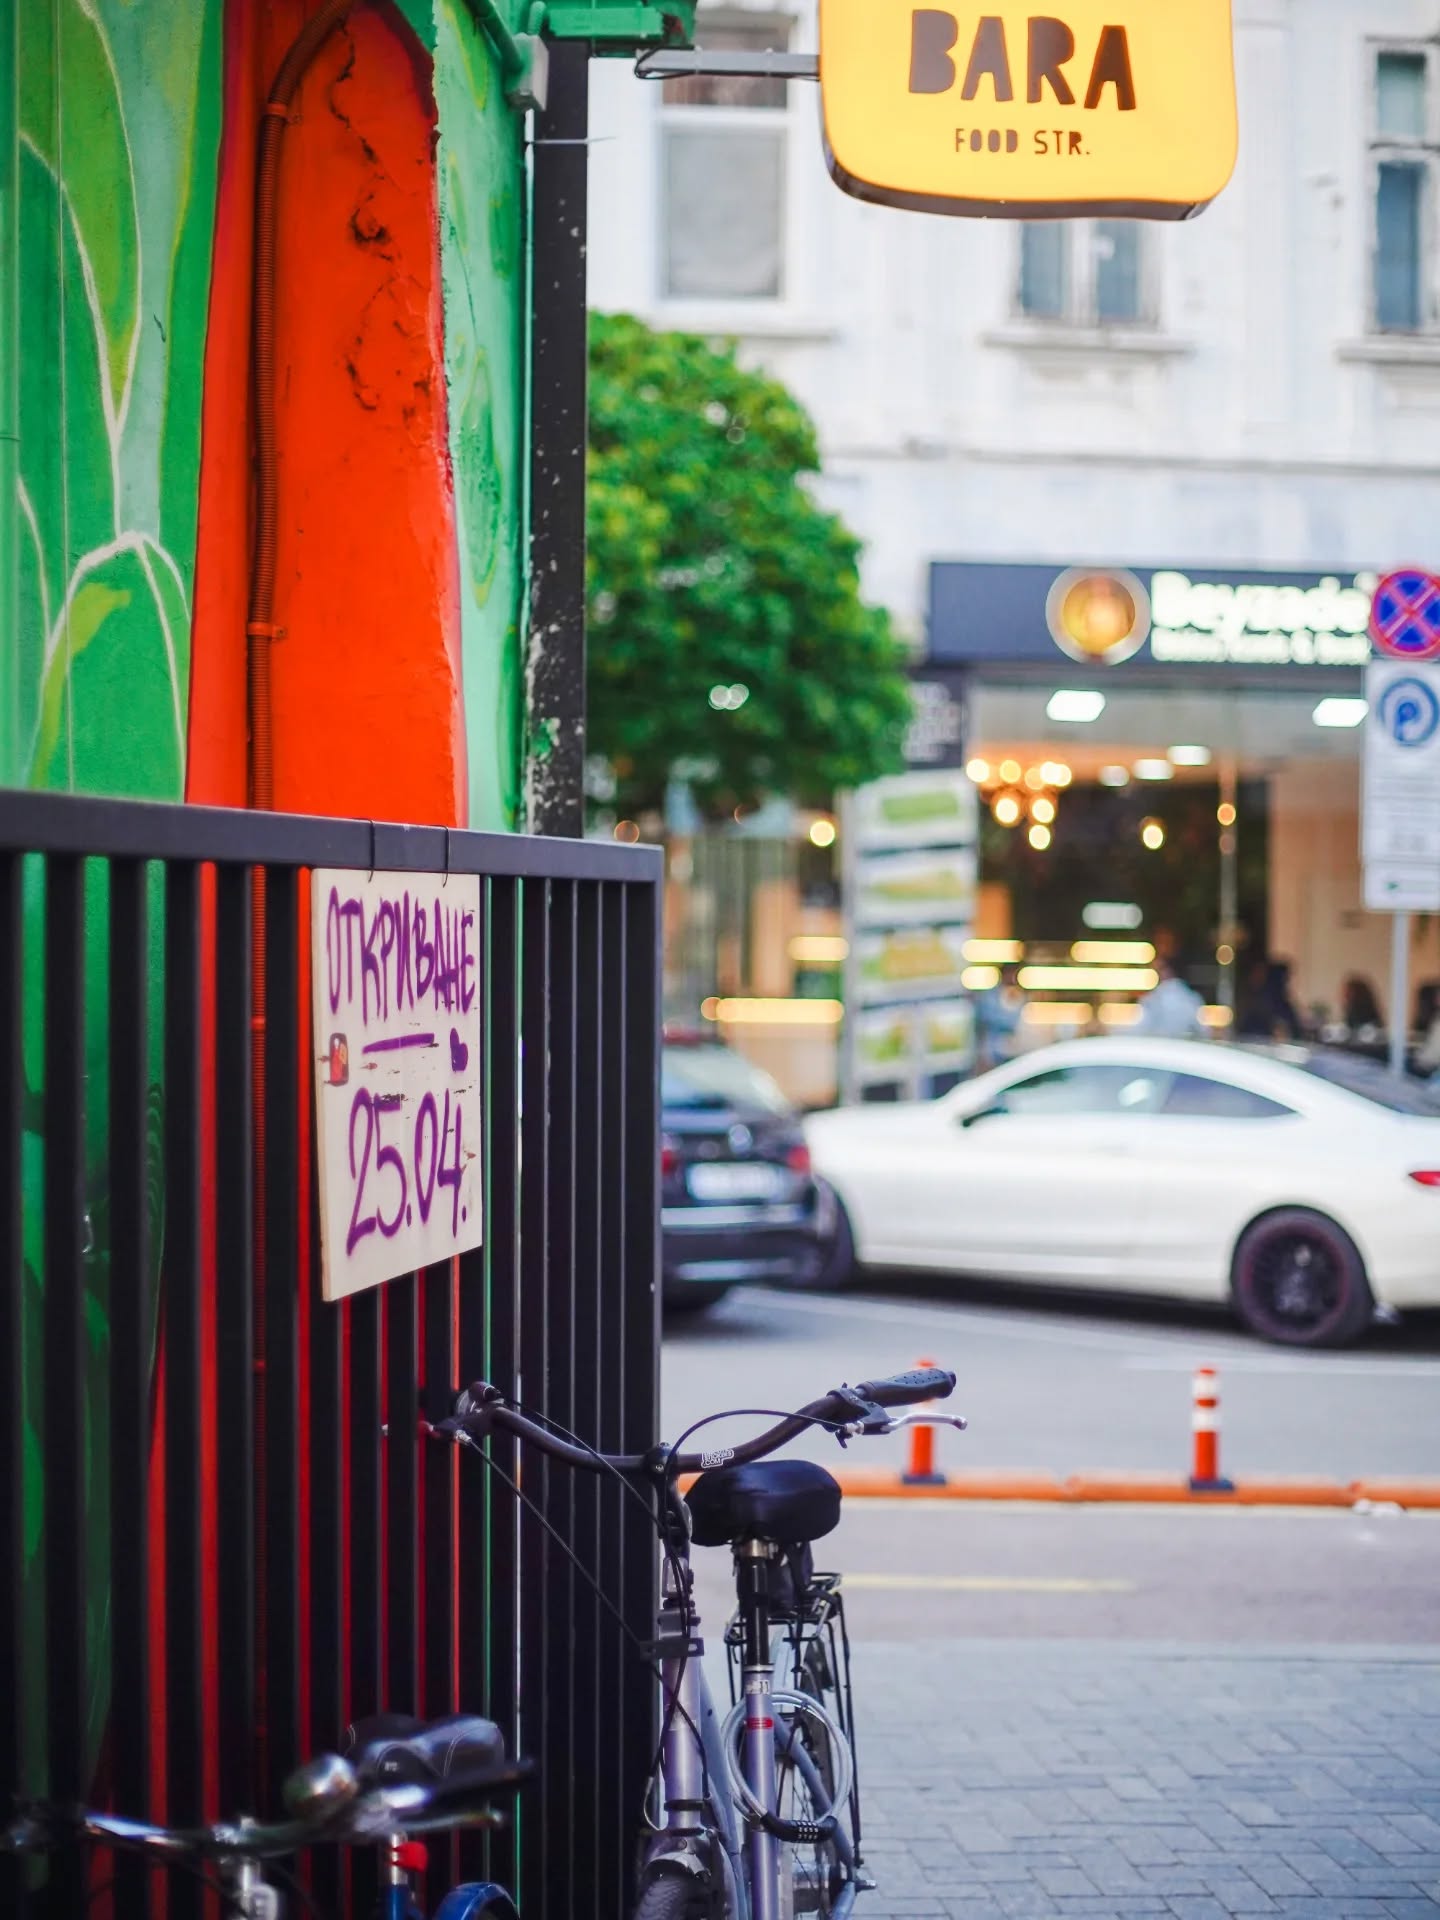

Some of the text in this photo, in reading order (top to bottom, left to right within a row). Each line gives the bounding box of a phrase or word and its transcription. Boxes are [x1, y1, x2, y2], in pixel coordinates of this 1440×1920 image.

[908, 9, 1136, 111] BARA
[955, 128, 1091, 155] FOOD STR.
[327, 885, 476, 1026] ОТКРИВАНЕ
[346, 1086, 468, 1257] 25.04.
